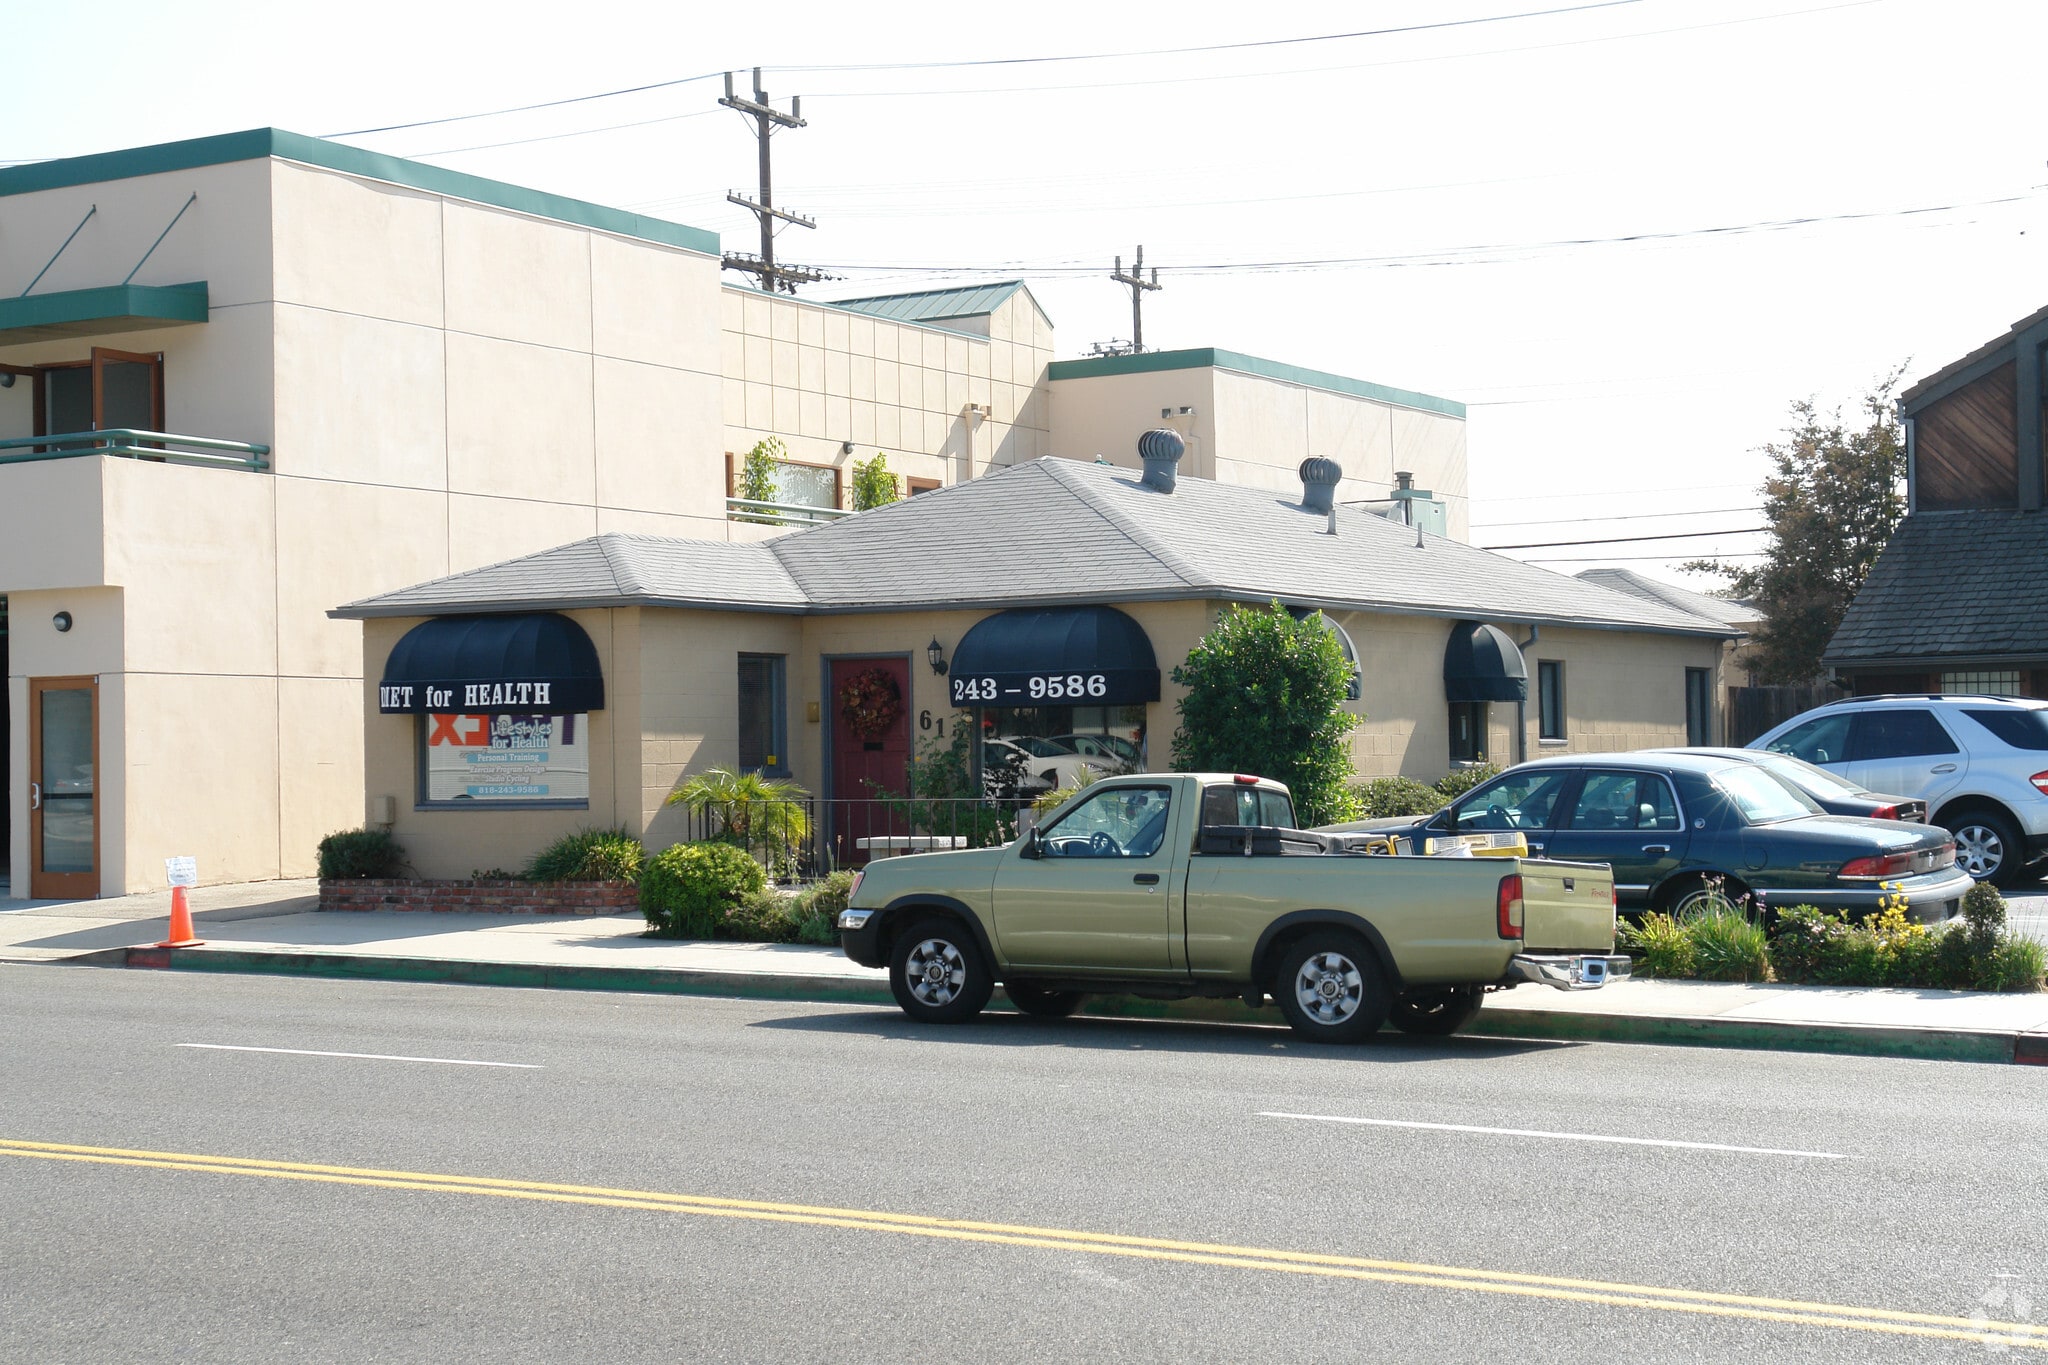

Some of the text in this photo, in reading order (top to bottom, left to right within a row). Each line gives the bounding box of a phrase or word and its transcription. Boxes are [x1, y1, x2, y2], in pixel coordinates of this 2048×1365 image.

[425, 685, 453, 708] for
[464, 682, 551, 706] HEALTH
[954, 676, 998, 701] 243
[1028, 674, 1107, 699] 9586
[492, 734, 549, 749] for Health
[477, 753, 540, 763] Personal Training
[496, 765, 523, 775] Program
[524, 764, 546, 775] Design
